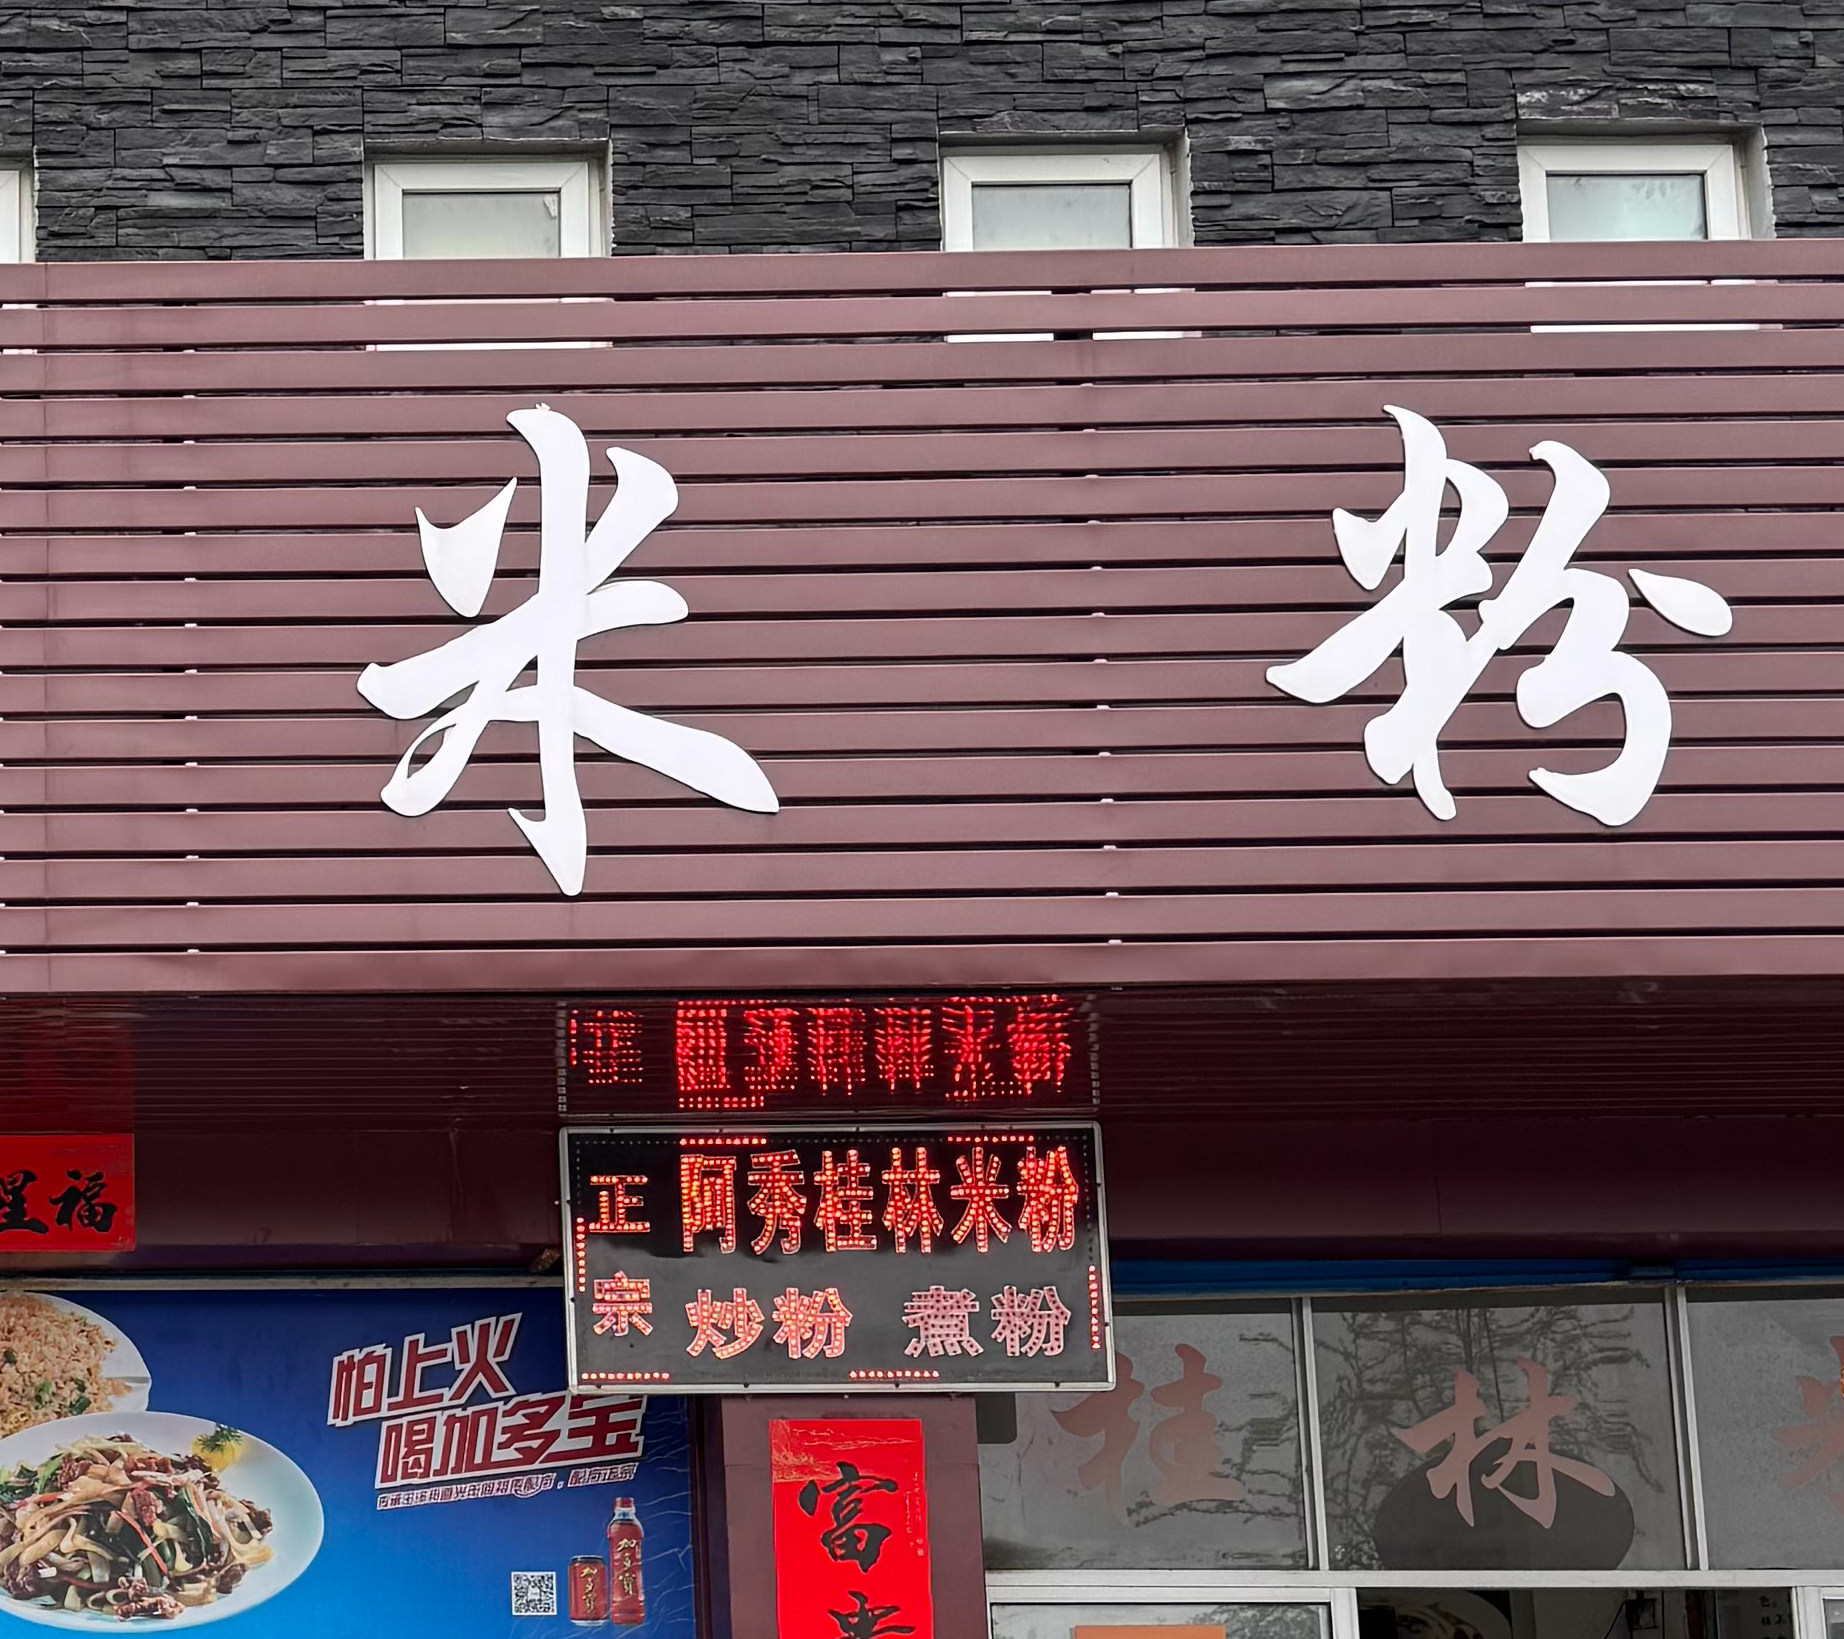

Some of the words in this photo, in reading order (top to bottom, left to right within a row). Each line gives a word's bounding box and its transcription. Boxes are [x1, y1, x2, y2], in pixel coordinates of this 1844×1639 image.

[679, 1146, 1079, 1255] 阿秀桂林米粉
[588, 1173, 654, 1338] 正宗
[329, 1314, 521, 1425] 怕上火
[684, 1286, 854, 1360] 炒粉
[901, 1284, 1072, 1358] 煮粉
[377, 1391, 644, 1487] 喝加多宝
